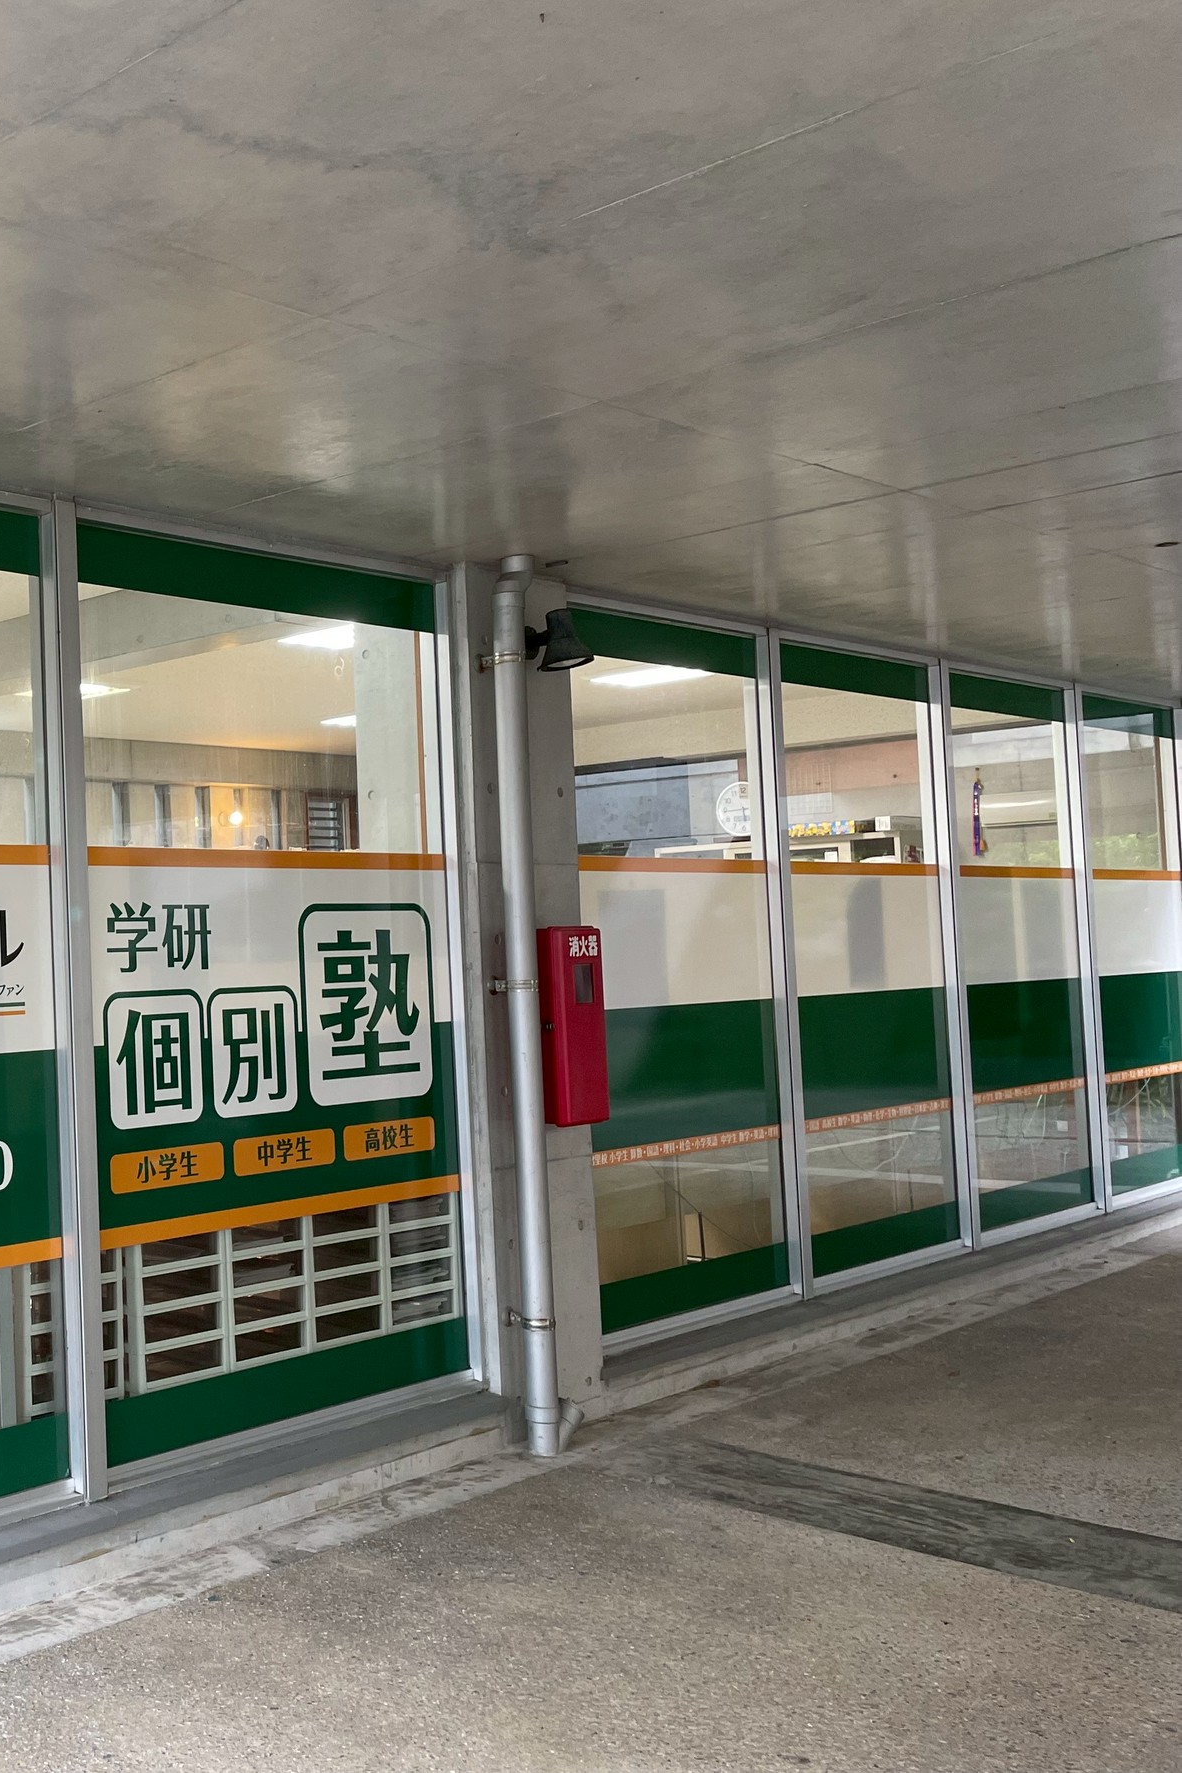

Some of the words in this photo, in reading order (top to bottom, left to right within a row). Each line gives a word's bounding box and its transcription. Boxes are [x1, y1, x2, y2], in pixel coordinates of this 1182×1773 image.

[106, 901, 212, 973] 学研
[569, 935, 598, 957] 消火器
[137, 1151, 199, 1183] 小学生
[257, 1136, 313, 1167] 中学生
[364, 1124, 415, 1152] 高校生
